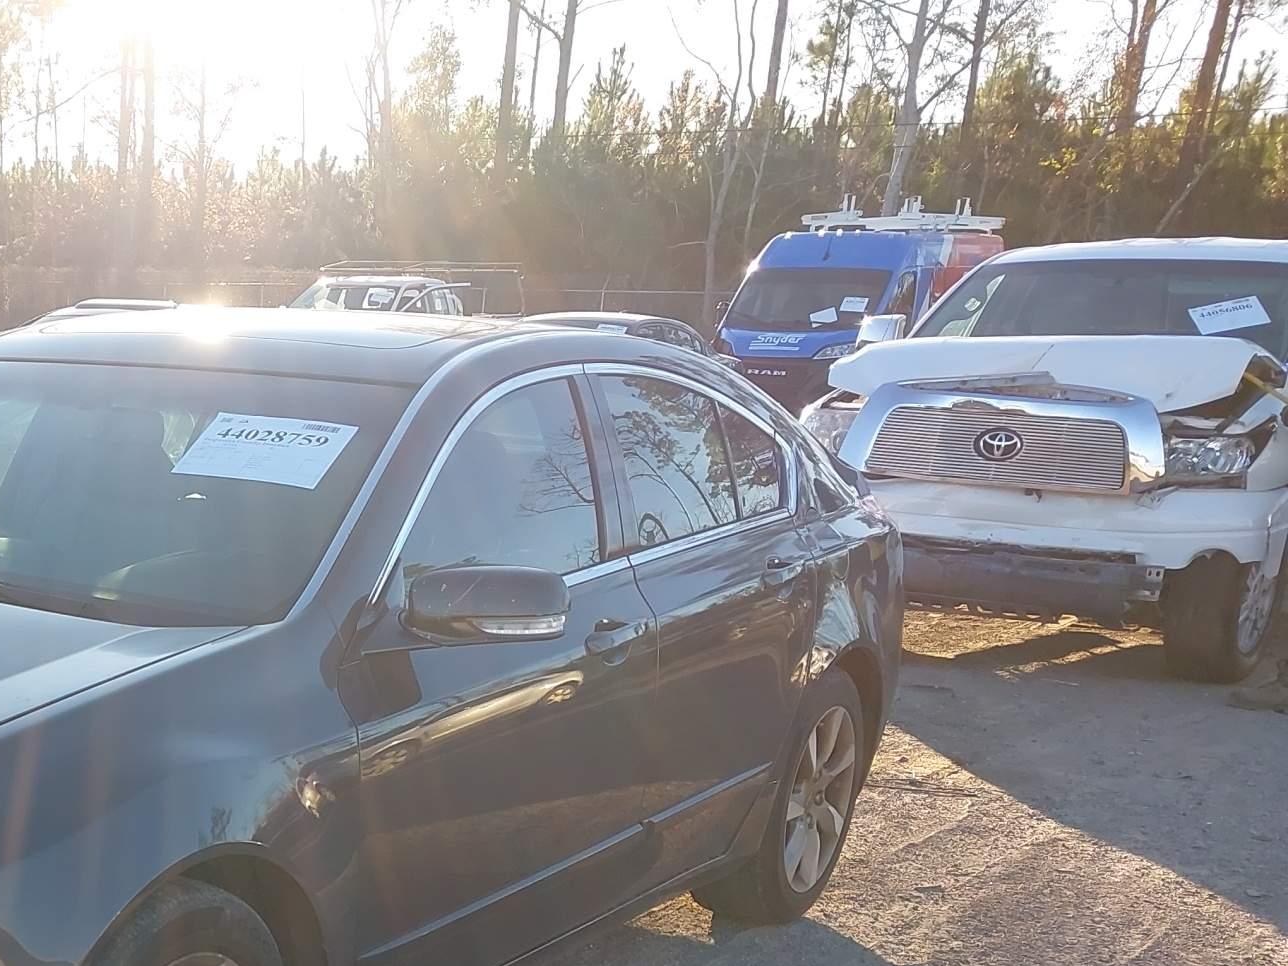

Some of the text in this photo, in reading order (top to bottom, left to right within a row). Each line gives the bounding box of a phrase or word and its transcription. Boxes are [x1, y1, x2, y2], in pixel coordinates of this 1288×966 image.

[751, 333, 808, 346] Snyder
[747, 368, 787, 376] RAM
[217, 427, 330, 447] 44028759
